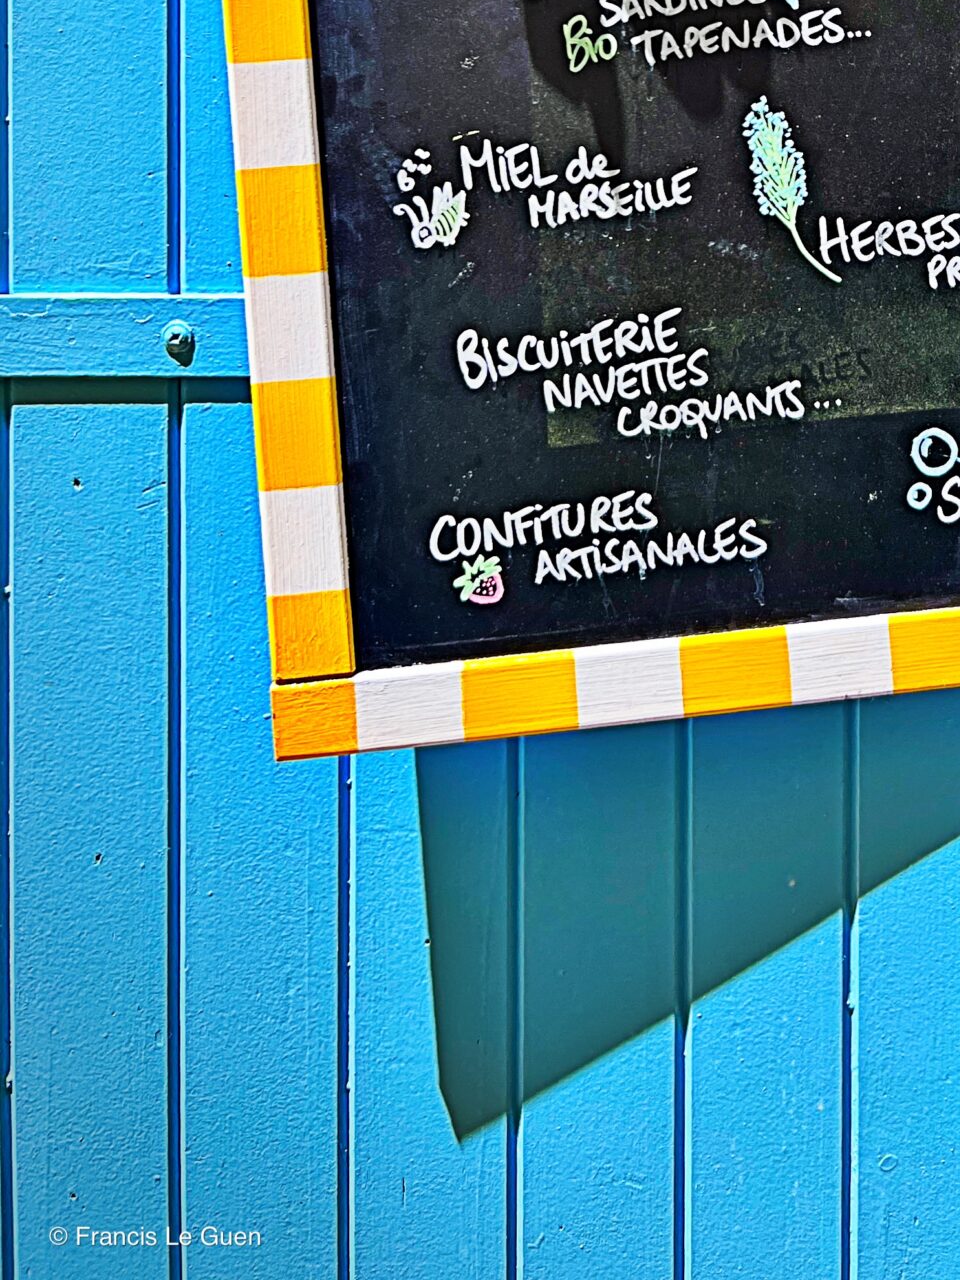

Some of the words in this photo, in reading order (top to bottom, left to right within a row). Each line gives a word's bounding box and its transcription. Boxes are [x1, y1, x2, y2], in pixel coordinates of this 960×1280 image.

[565, 146, 620, 185] de
[820, 210, 960, 265] HERBES
[542, 347, 709, 412] NAVETTES
